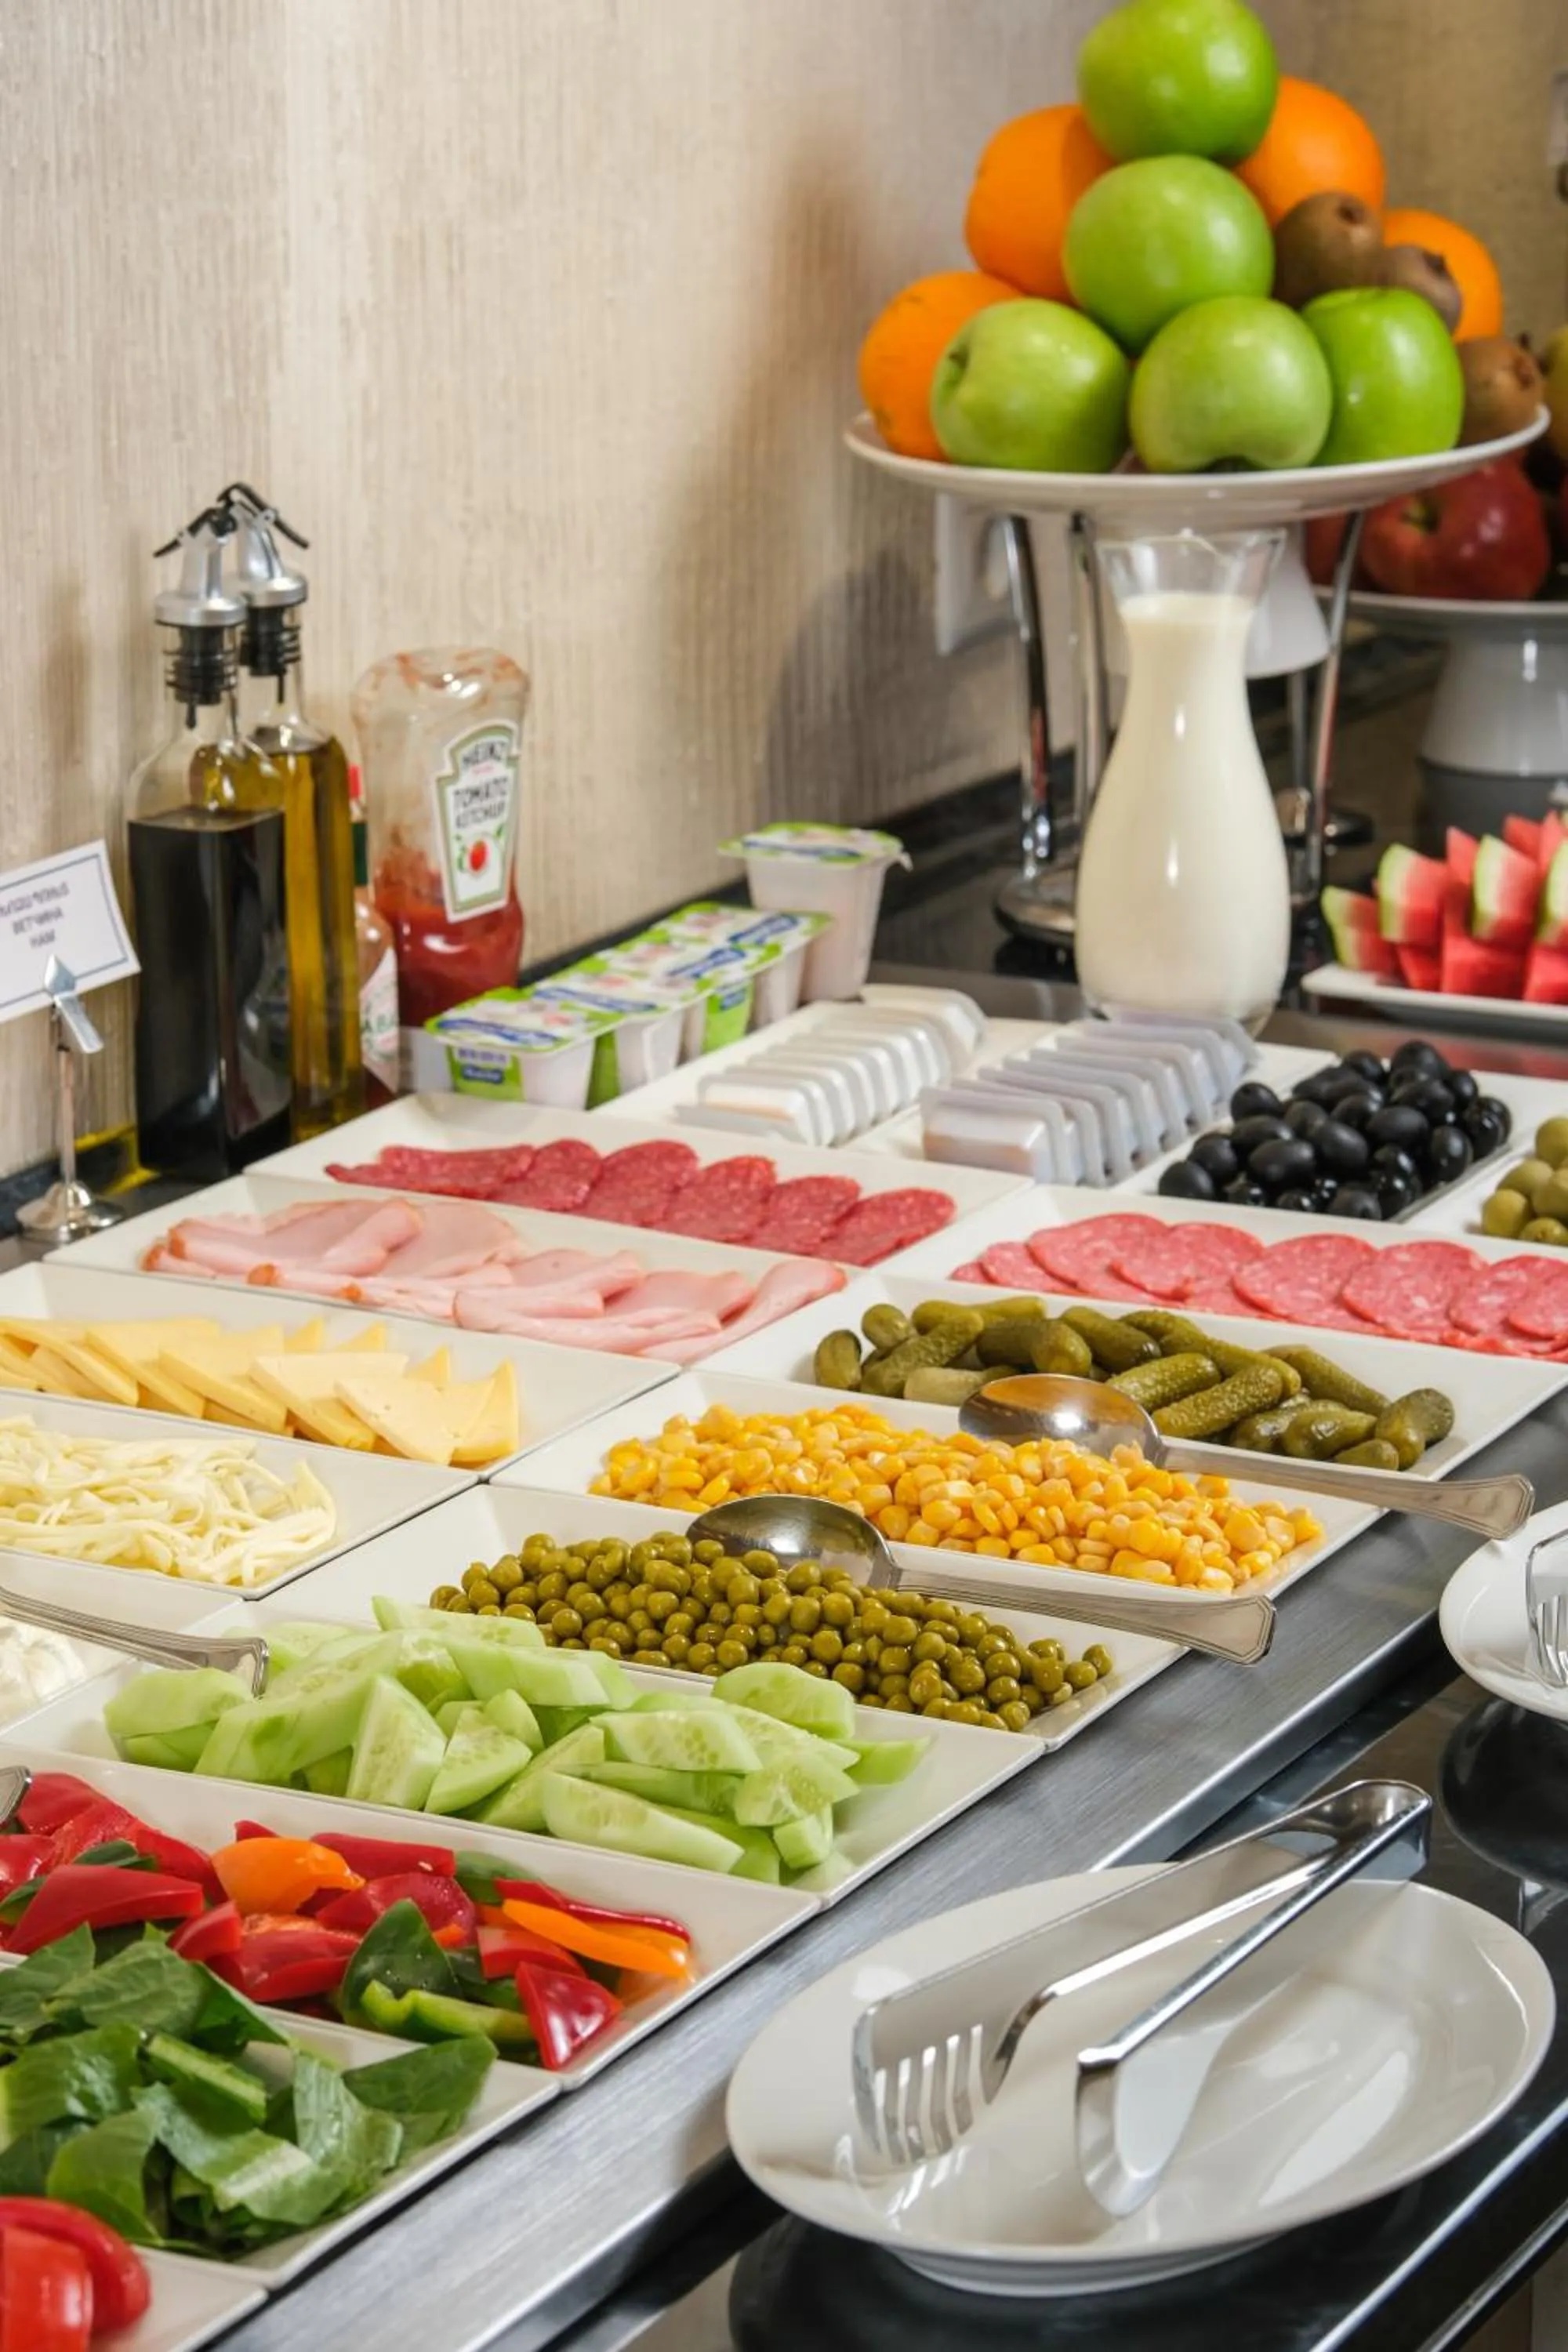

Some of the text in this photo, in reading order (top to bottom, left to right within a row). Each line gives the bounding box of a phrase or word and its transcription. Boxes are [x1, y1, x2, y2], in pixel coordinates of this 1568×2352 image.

[461, 741, 506, 768] HEINZ
[455, 777, 508, 808] TOMATO
[456, 801, 506, 829] KETCHUP
